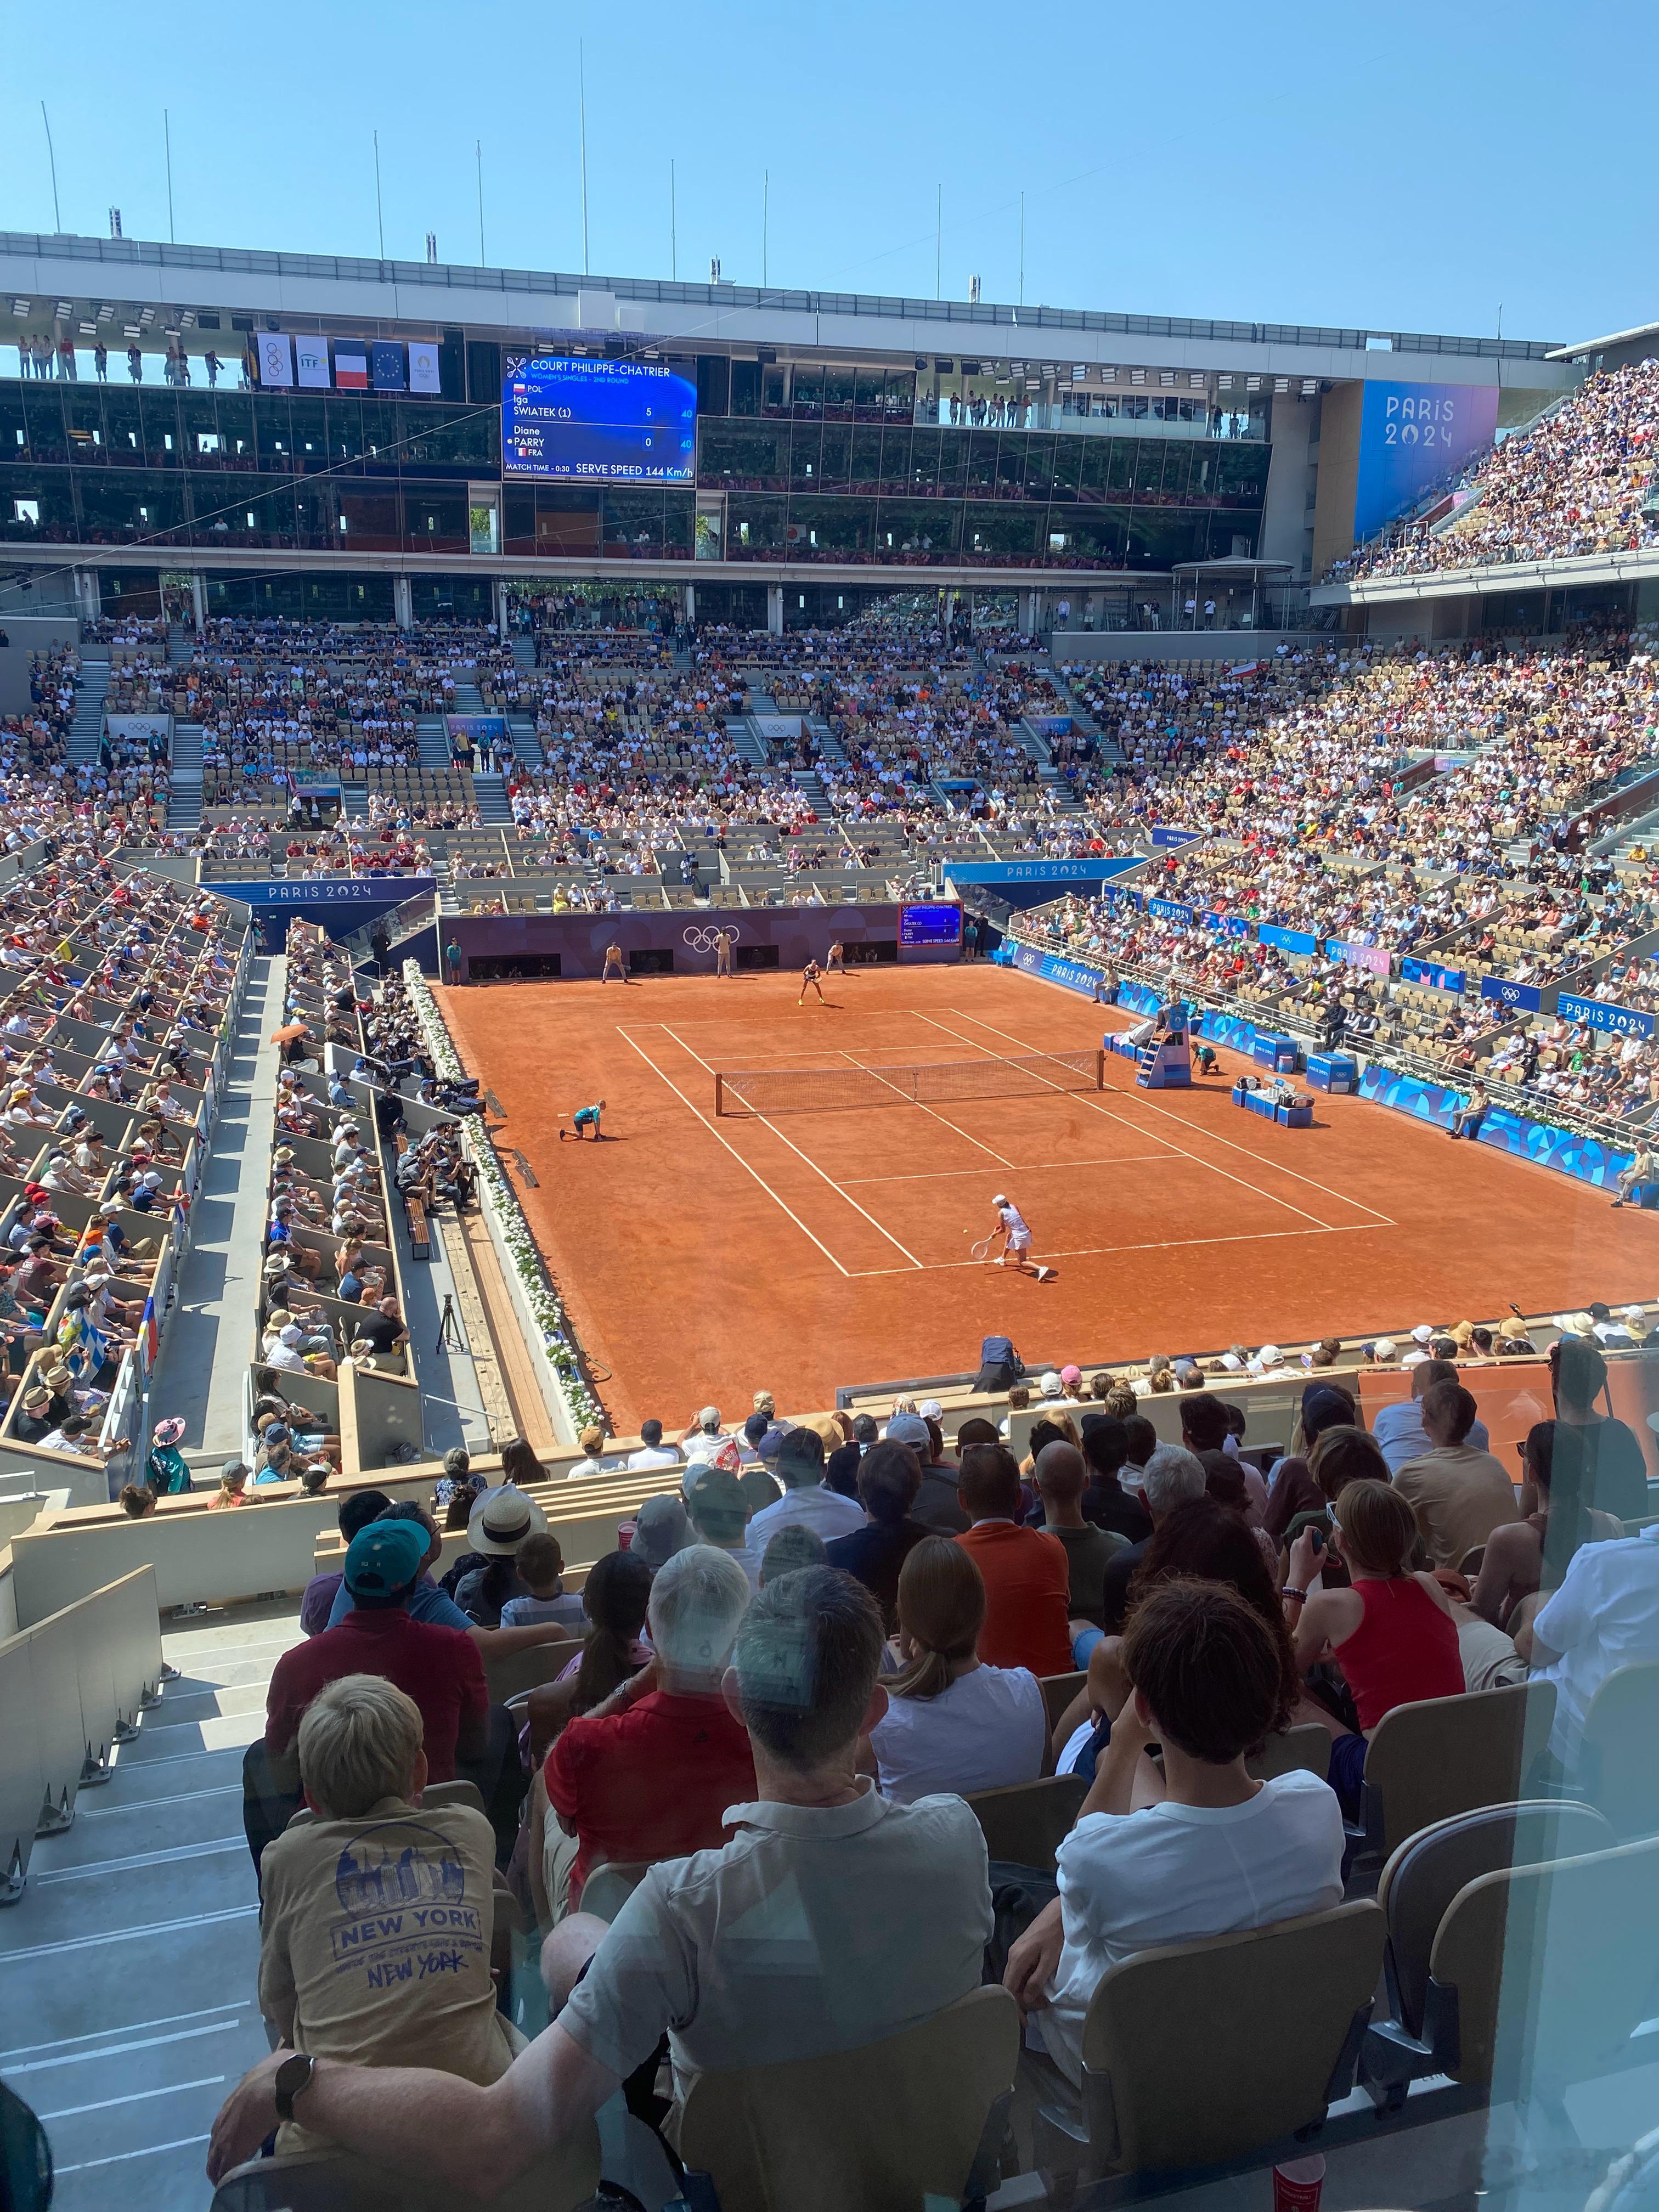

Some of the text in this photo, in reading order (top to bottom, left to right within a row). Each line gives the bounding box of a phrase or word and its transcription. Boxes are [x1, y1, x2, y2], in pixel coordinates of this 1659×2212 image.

[301, 359, 318, 368] ITF
[531, 359, 670, 377] COURT PHILIPPE-CHATRIER
[514, 394, 528, 405] Iga
[514, 407, 571, 418] SWIATEK (1)
[646, 408, 652, 416] 5
[681, 410, 692, 418] 40
[1386, 396, 1454, 422] PARIS
[514, 426, 540, 436] Diane
[1385, 423, 1452, 448] 2024
[514, 437, 545, 447] PARRY
[646, 438, 651, 447] 0
[680, 440, 692, 449] 40
[576, 463, 693, 478] SERVE SPEED 144 Km/h
[1007, 864, 1086, 877] PARIS 2024
[269, 885, 371, 899] PARIS 2024
[1153, 902, 1189, 919] PARIS 2024
[1331, 946, 1384, 968] PARIS 2024
[1051, 964, 1097, 989] PARIS 2024
[1566, 1003, 1645, 1034] PARIS 2024
[341, 1909, 477, 1949] NEW YORK
[367, 1957, 413, 1988] NEW
[417, 1950, 469, 1979] YORK
